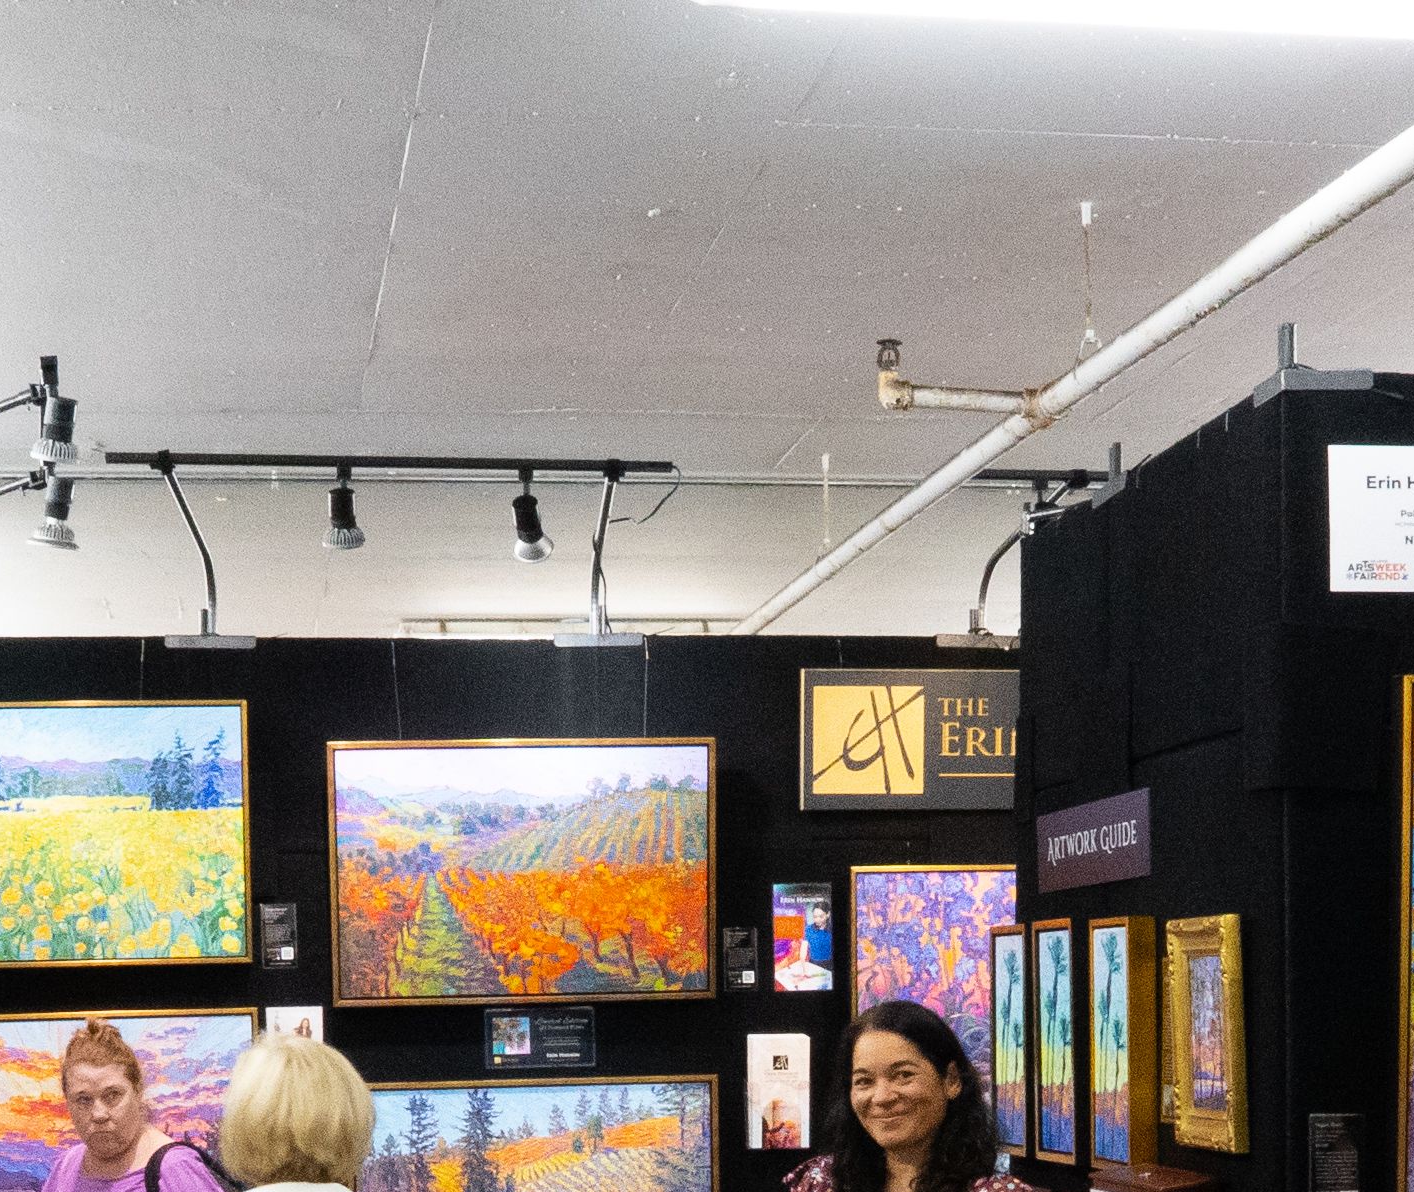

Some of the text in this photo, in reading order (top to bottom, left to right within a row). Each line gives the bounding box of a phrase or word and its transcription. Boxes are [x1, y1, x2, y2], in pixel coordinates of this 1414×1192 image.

[1366, 476, 1402, 489] Erin
[937, 697, 989, 717] THE
[1047, 819, 1137, 867] ARTWORK GUIDE
